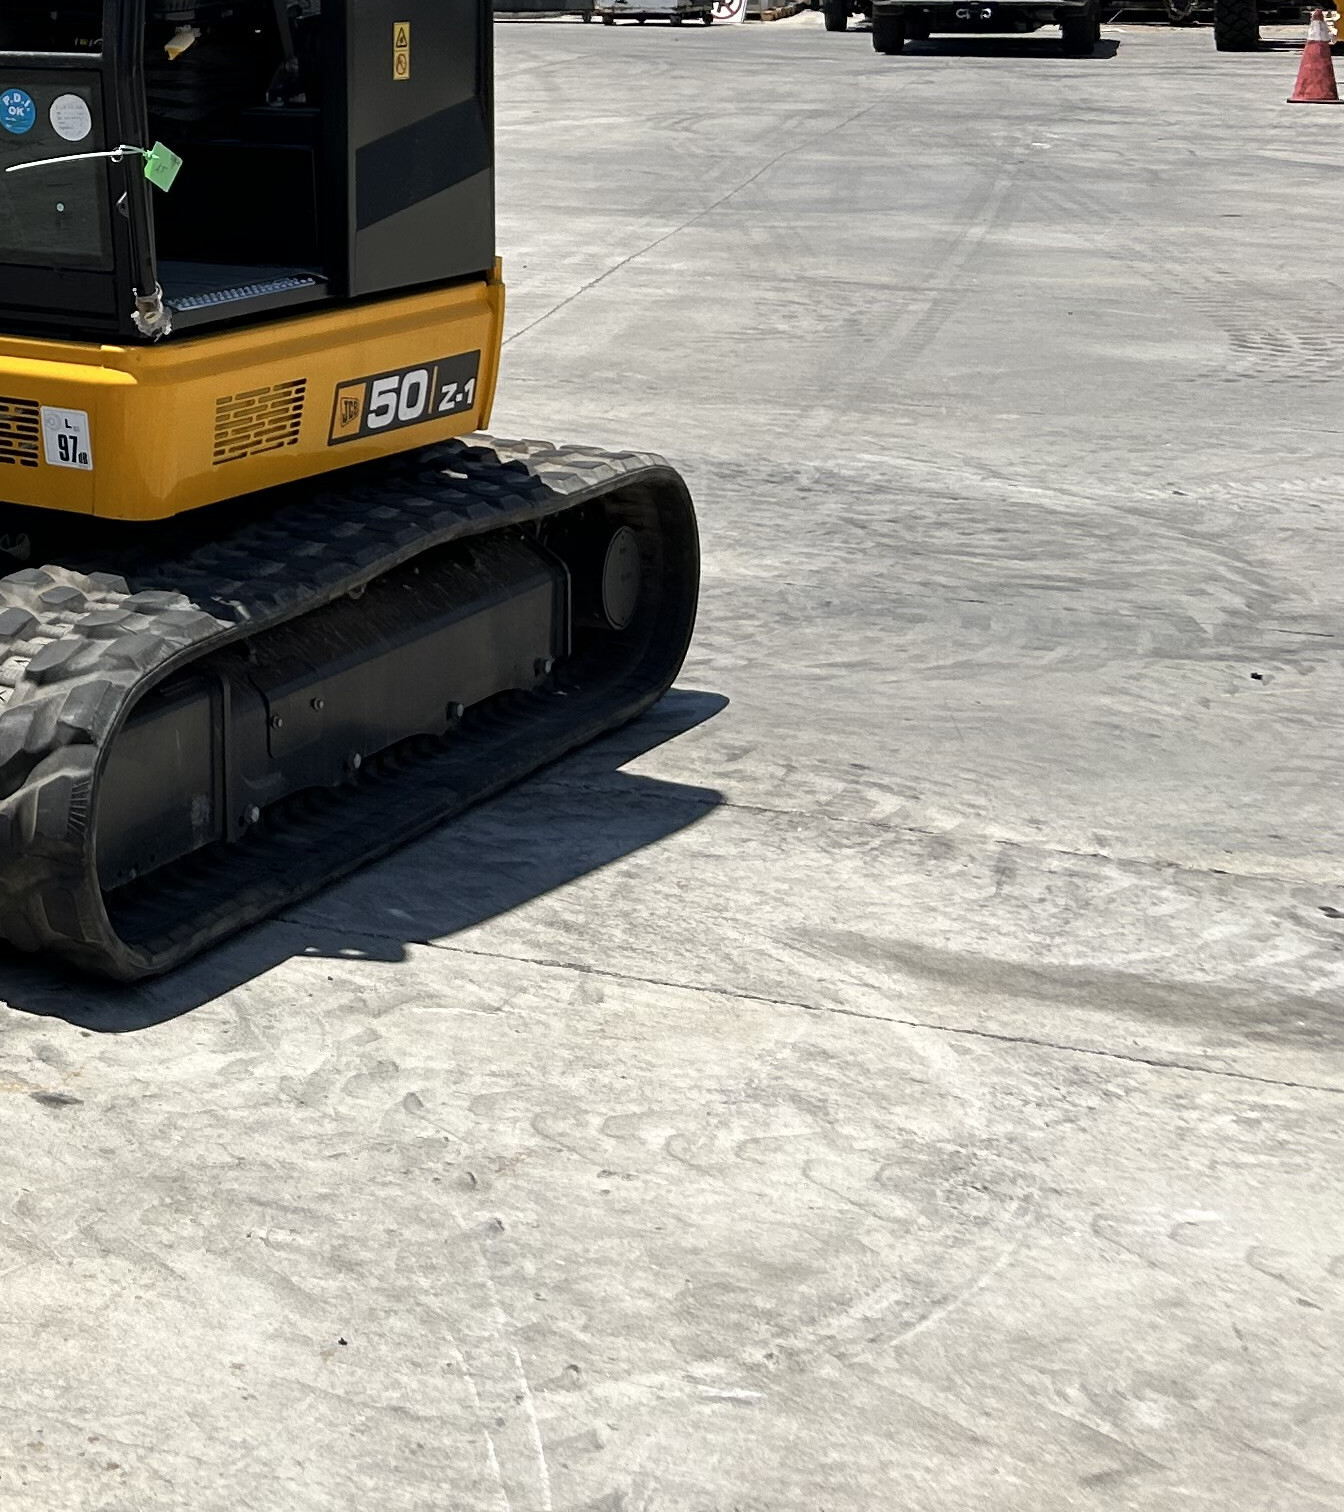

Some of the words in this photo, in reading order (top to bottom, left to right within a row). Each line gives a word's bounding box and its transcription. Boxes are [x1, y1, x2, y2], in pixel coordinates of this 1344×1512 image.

[8, 105, 25, 117] OK
[367, 369, 429, 429] 50
[438, 377, 477, 412] Z-1
[57, 433, 78, 463] 97
